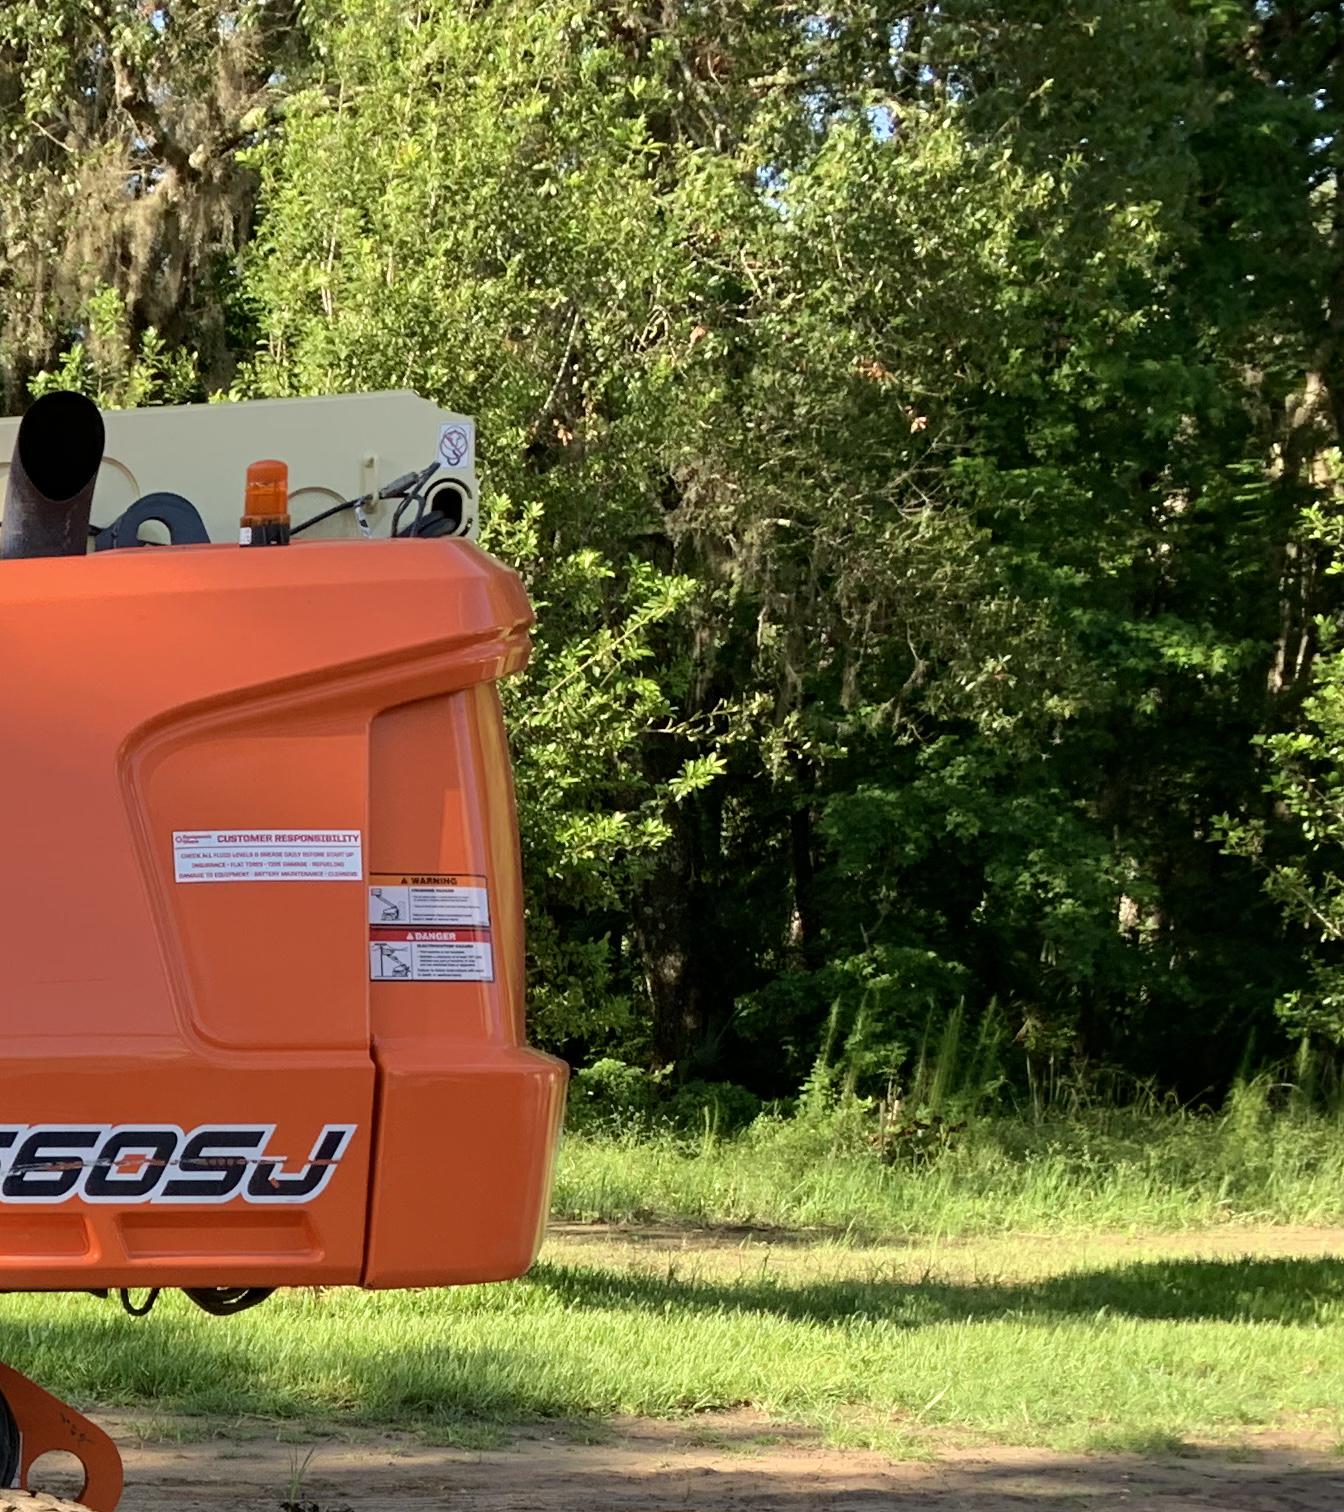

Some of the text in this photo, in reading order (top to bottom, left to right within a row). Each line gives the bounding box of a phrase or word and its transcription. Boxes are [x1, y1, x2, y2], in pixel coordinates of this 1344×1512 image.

[217, 834, 272, 844] CUSTOMER
[274, 833, 359, 843] RESPONSIBILITY
[410, 877, 457, 886] WARNING
[415, 931, 457, 941] DANGER
